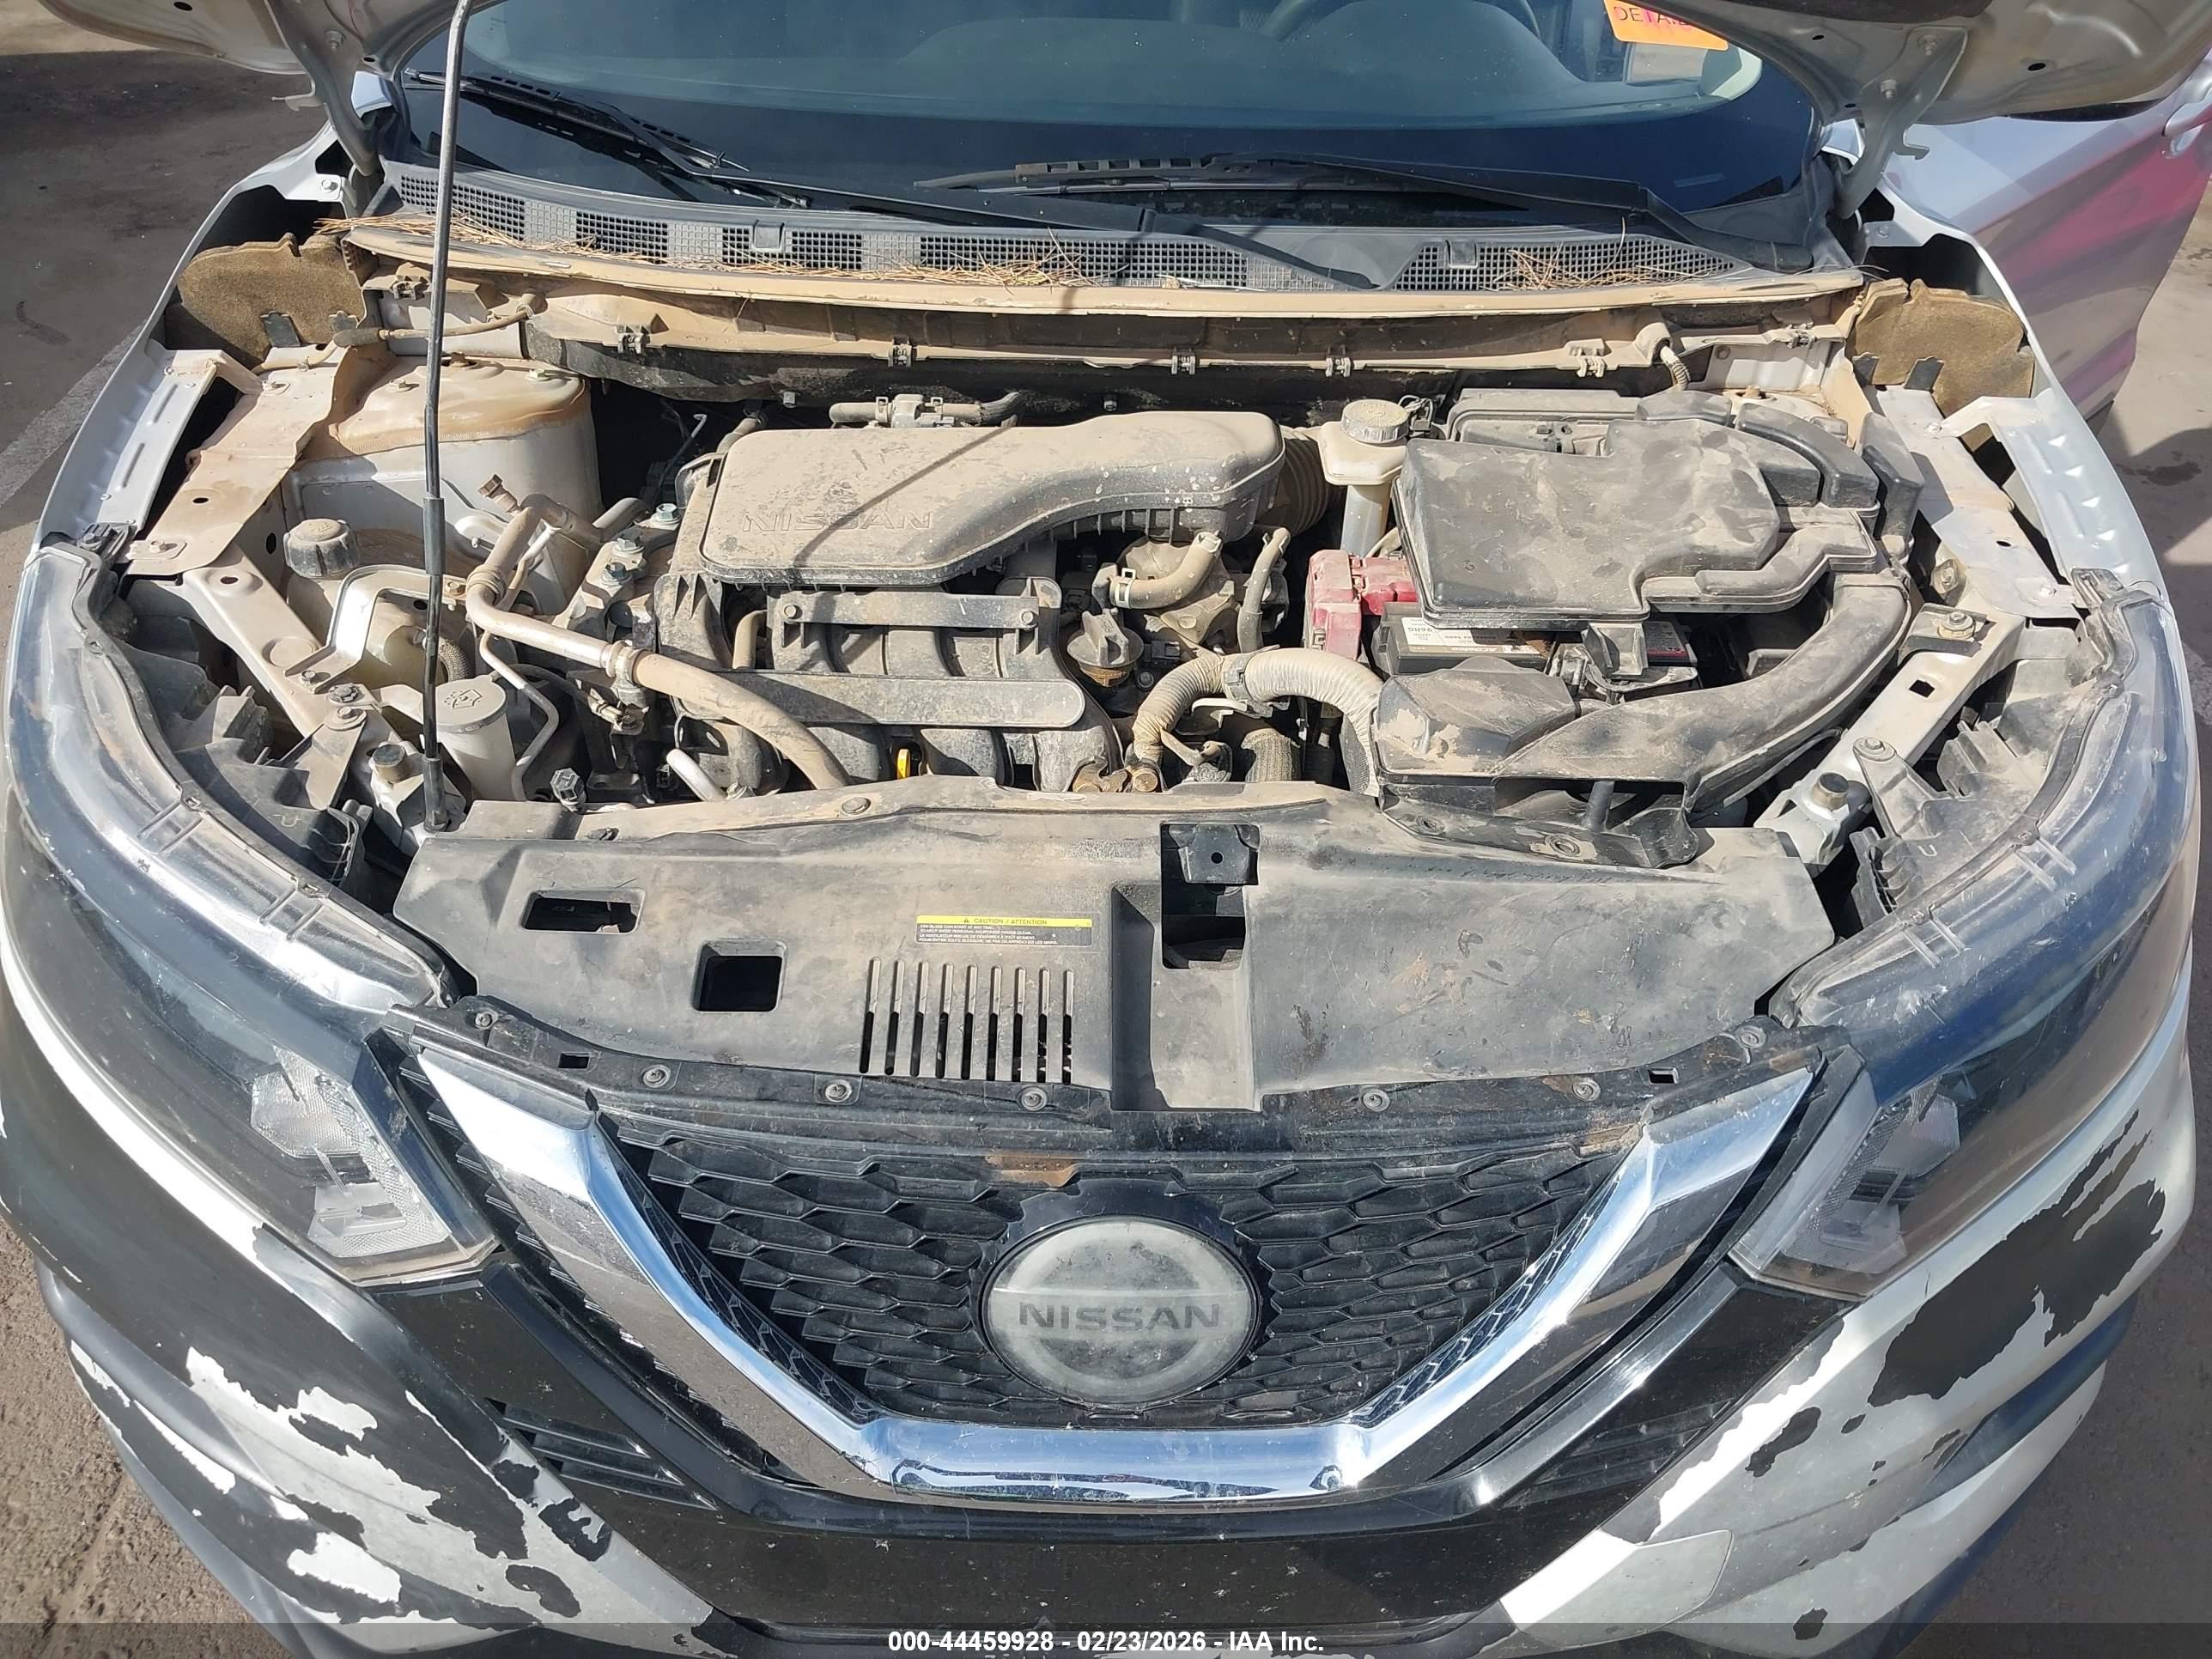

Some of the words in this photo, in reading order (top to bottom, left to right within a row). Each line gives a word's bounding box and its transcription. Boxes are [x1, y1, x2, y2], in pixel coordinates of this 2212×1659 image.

[1613, 6, 1690, 26] DETA
[742, 511, 934, 532] NISSAN
[1019, 1302, 1219, 1331] NISSAN
